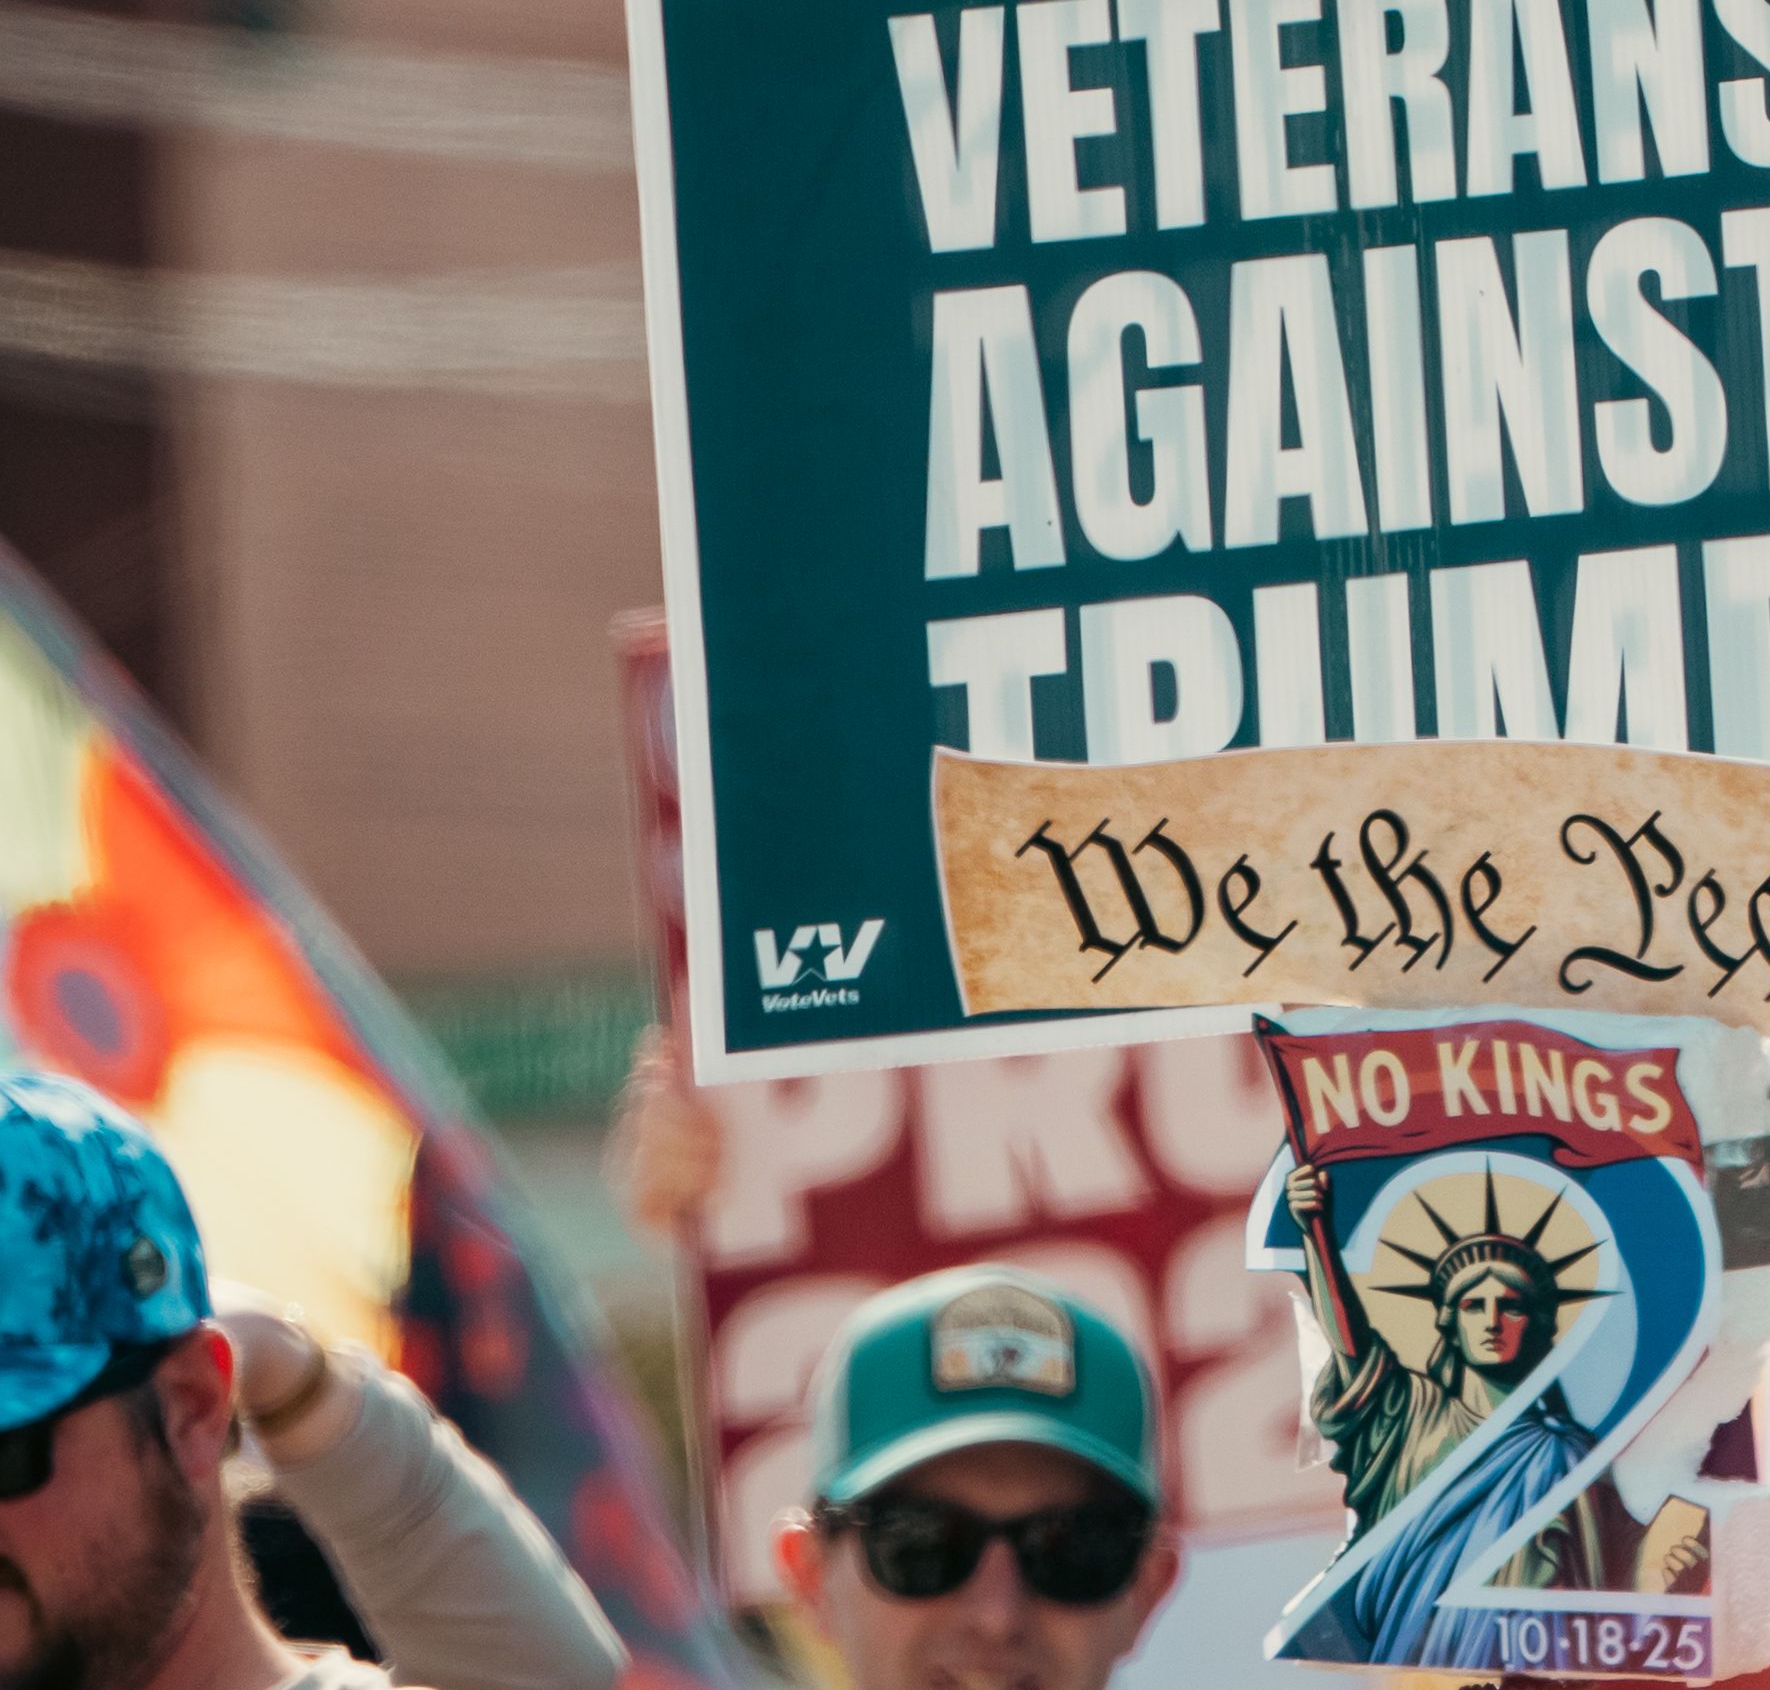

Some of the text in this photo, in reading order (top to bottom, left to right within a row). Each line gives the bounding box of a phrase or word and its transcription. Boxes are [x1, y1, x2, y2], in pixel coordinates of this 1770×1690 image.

[1014, 816, 1300, 984] We
[1310, 808, 1538, 984] the
[761, 987, 860, 1013] VoteVets
[1300, 1039, 1674, 1136] NO KINGS
